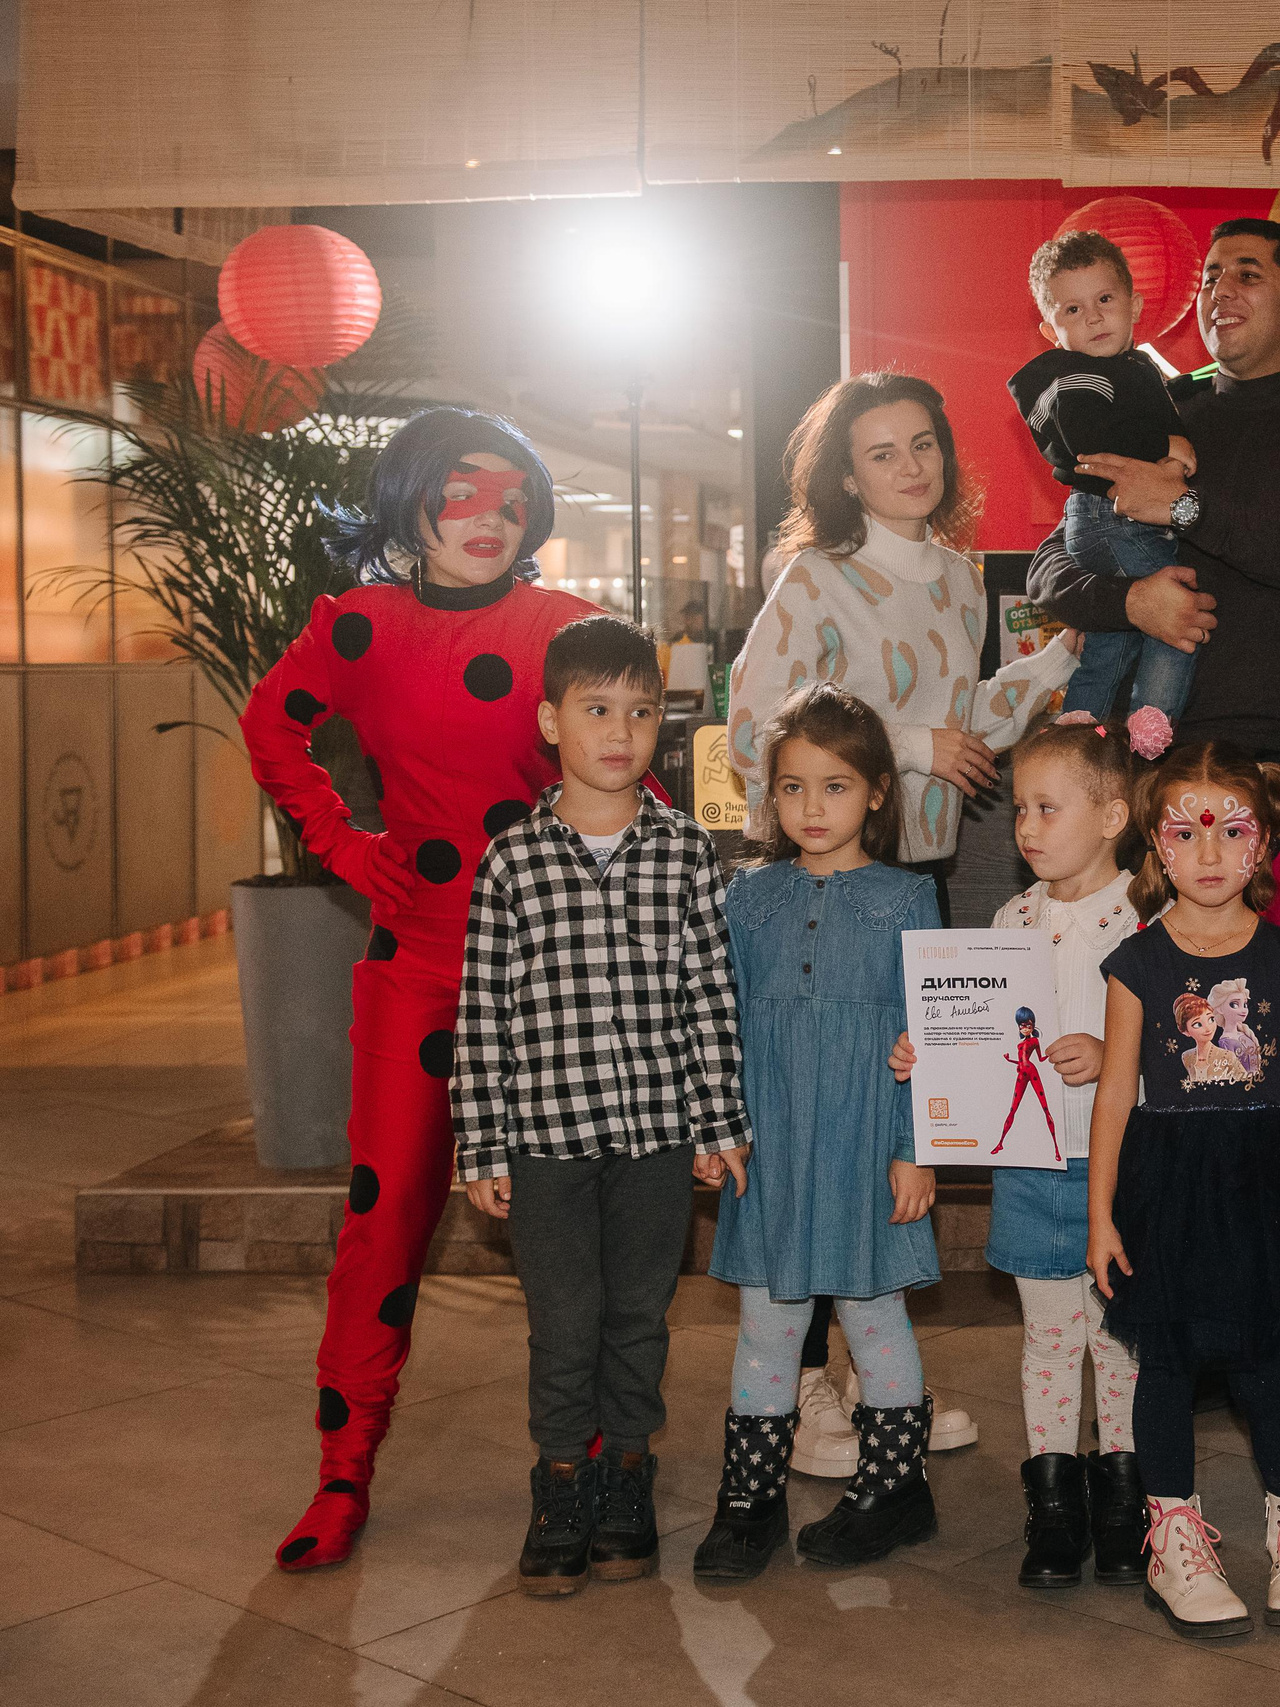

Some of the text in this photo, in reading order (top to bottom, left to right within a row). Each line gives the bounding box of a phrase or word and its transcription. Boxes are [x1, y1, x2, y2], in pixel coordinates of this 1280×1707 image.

[724, 813, 743, 824] Еда
[921, 977, 1008, 991] ДИПЛОМ
[922, 995, 970, 1003] вручается
[729, 1500, 751, 1509] reima
